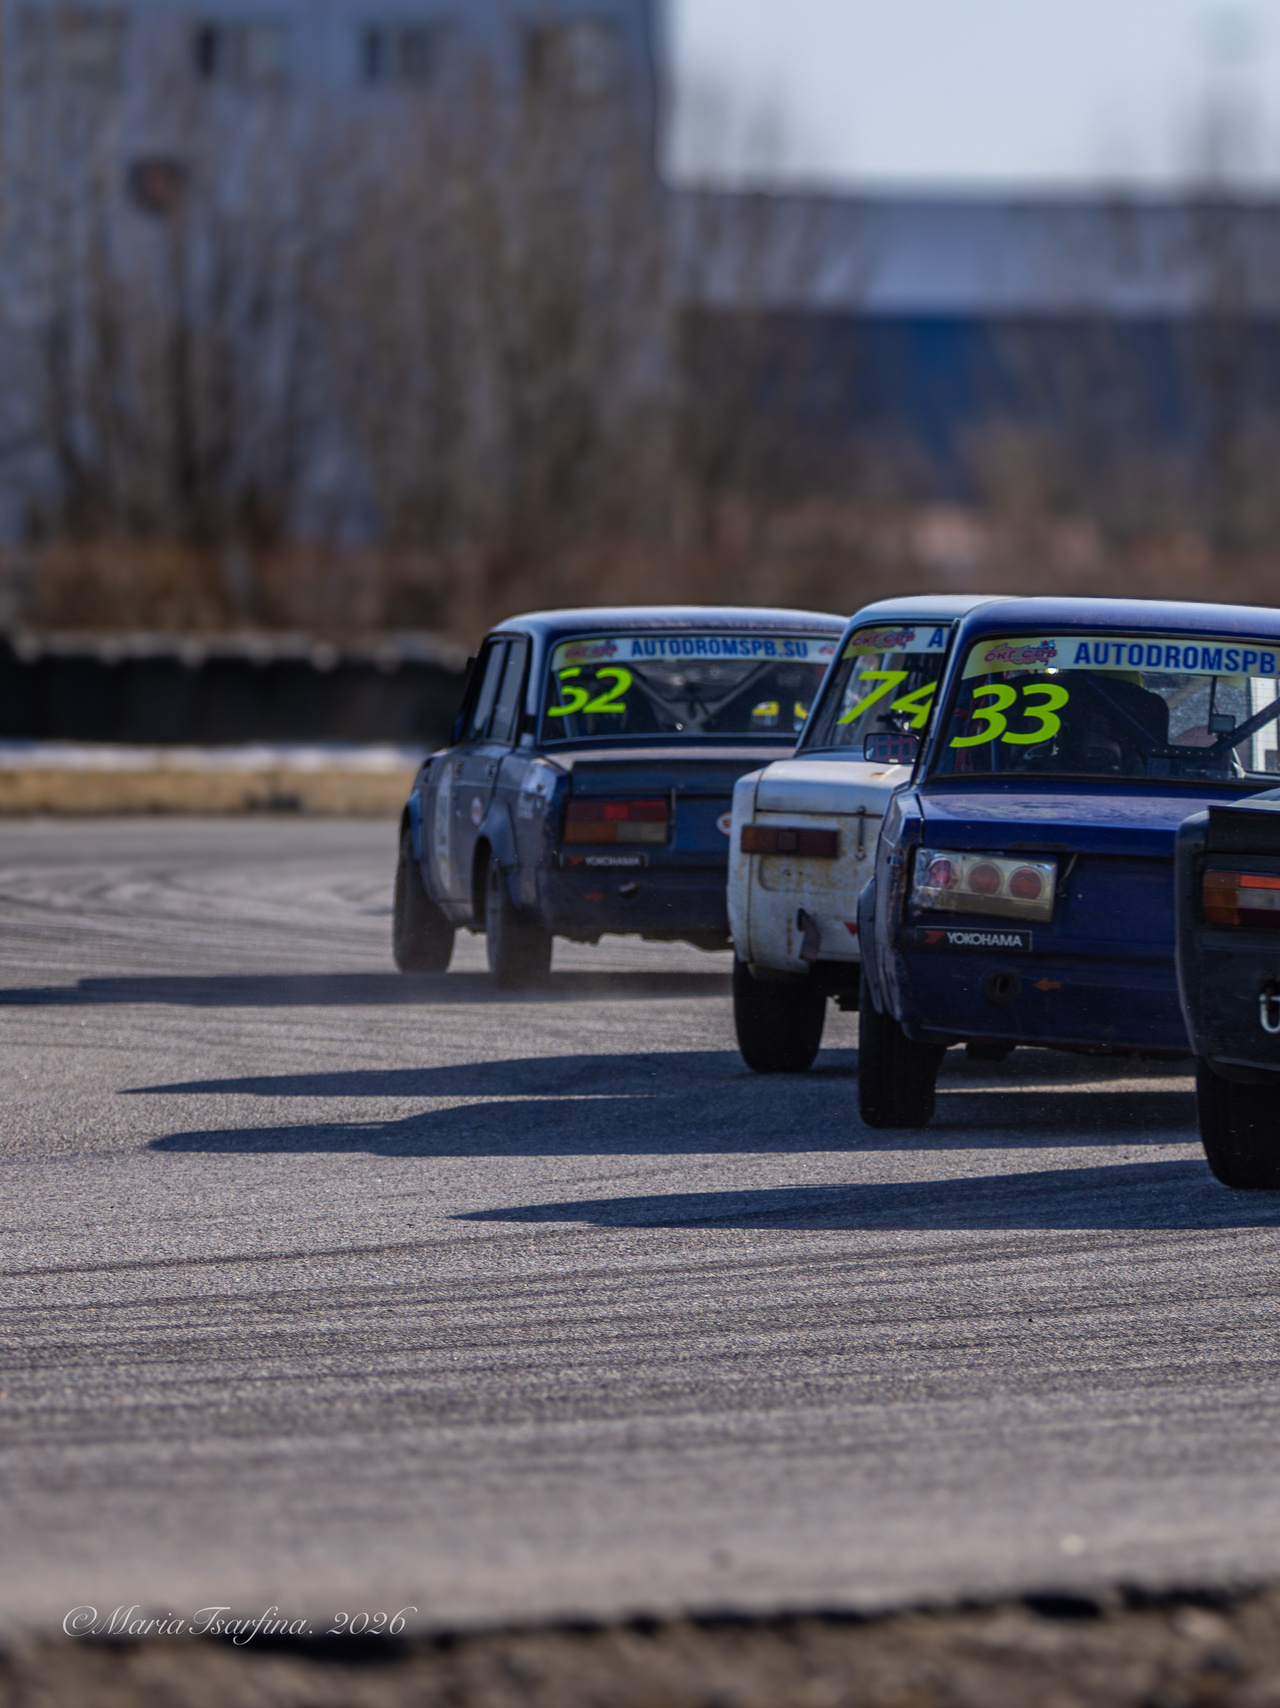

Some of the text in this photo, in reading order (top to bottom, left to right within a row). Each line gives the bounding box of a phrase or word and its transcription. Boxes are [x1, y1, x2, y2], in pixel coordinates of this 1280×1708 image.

[631, 639, 808, 658] AUTODROMSPB.SU
[547, 666, 633, 717] 52
[837, 670, 938, 729] 74
[949, 683, 1069, 747] 33
[946, 931, 1023, 947] YOKOHAMA
